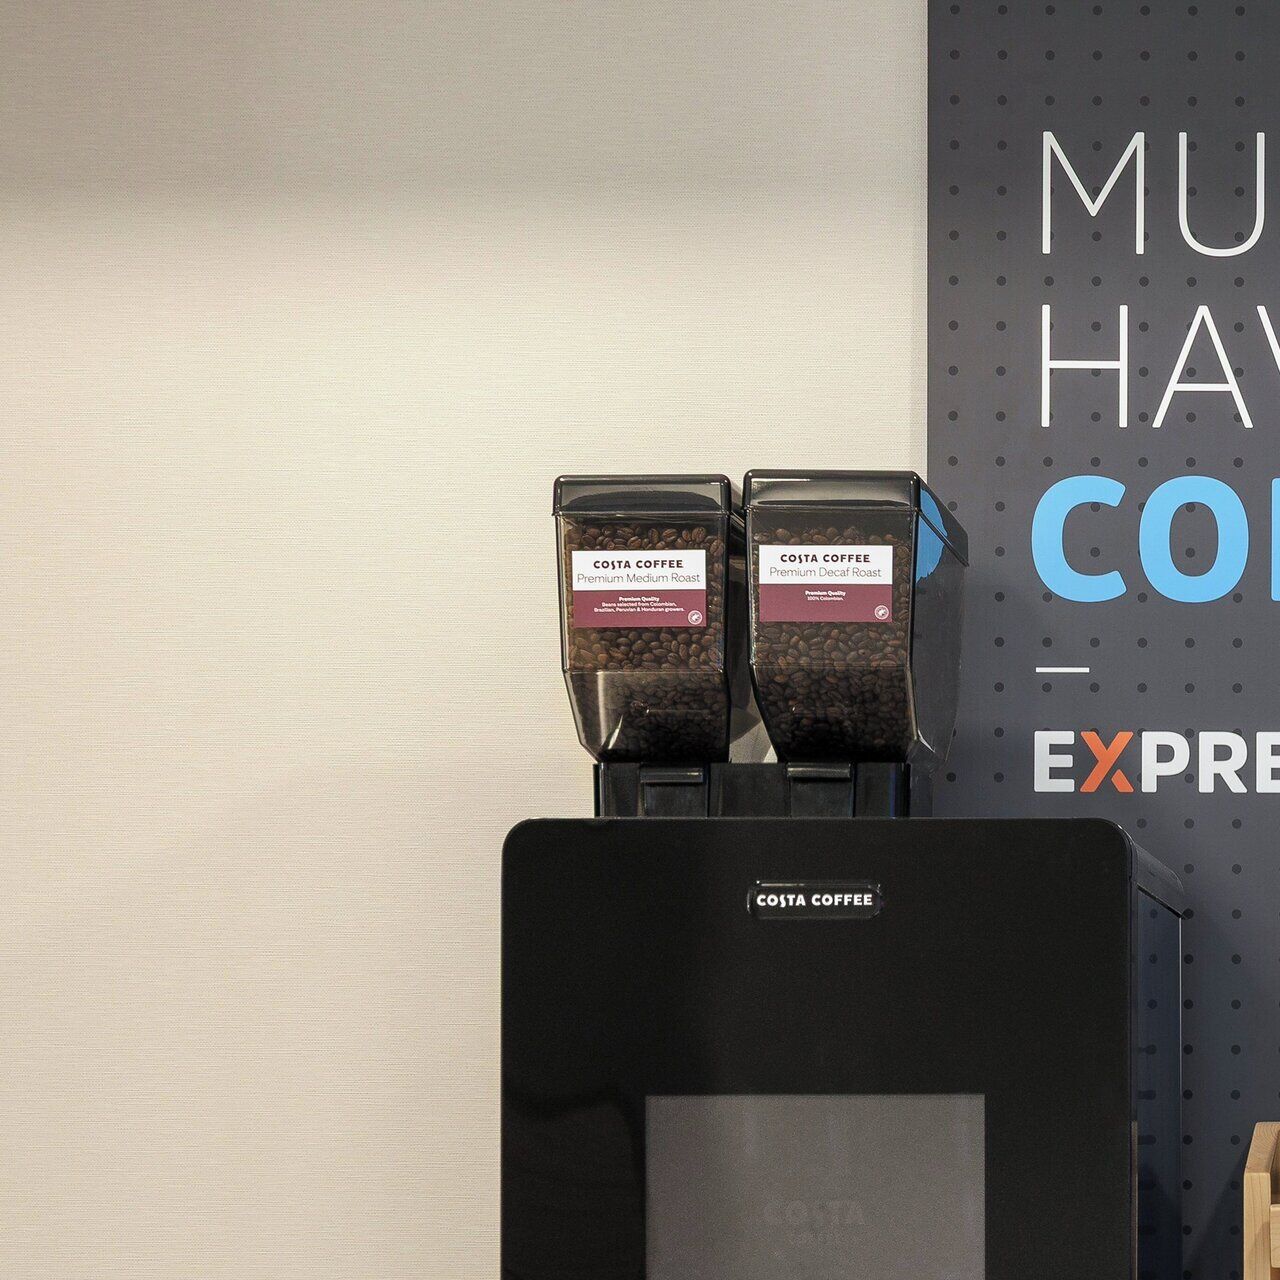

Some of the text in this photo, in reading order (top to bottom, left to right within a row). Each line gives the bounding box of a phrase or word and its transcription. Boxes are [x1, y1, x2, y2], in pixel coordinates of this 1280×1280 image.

[780, 554, 870, 563] COSTA COFFEE
[593, 560, 684, 570] COSTA COFFEE
[769, 567, 882, 577] Premium Decaf Roast
[577, 572, 701, 583] Premium Medium Roast
[756, 893, 873, 908] COSTA COFFEE
